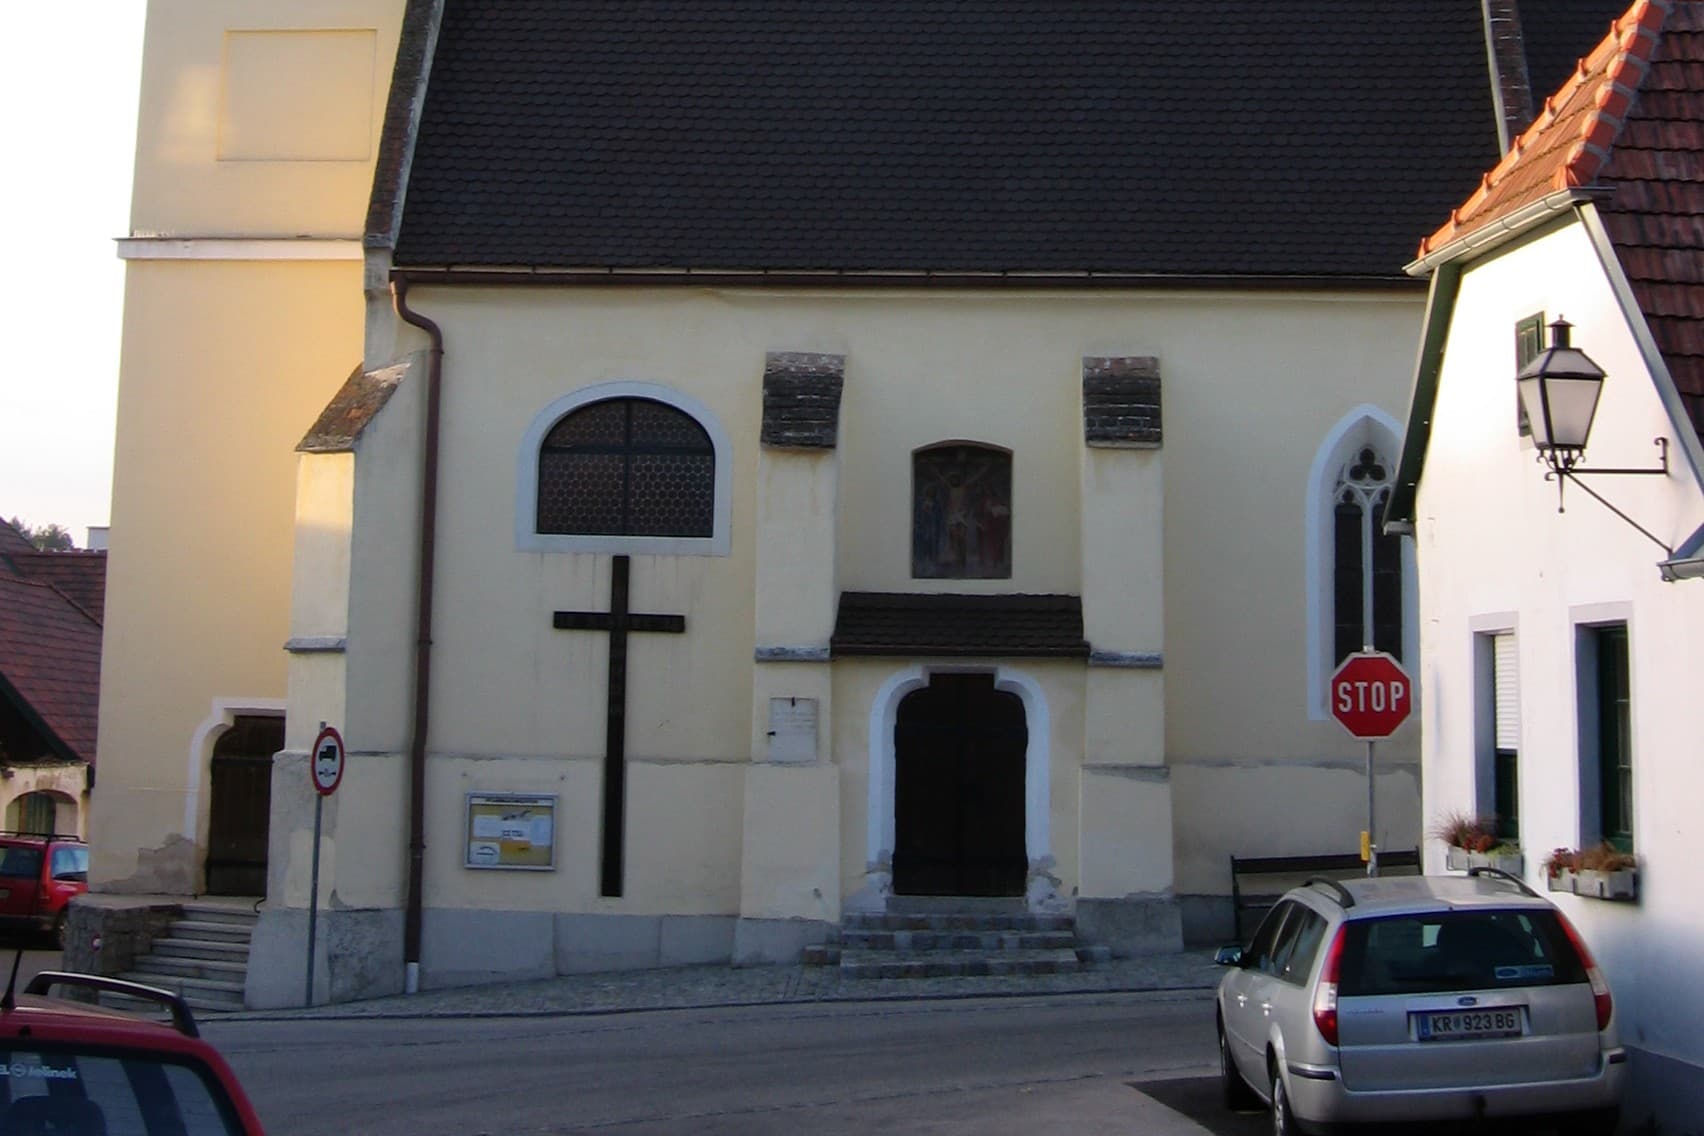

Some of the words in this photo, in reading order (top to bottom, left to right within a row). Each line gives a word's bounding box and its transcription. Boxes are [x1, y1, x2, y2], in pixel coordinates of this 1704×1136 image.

[1337, 680, 1404, 713] STOP
[1431, 1015, 1452, 1033] KR
[1463, 1014, 1492, 1031] 923
